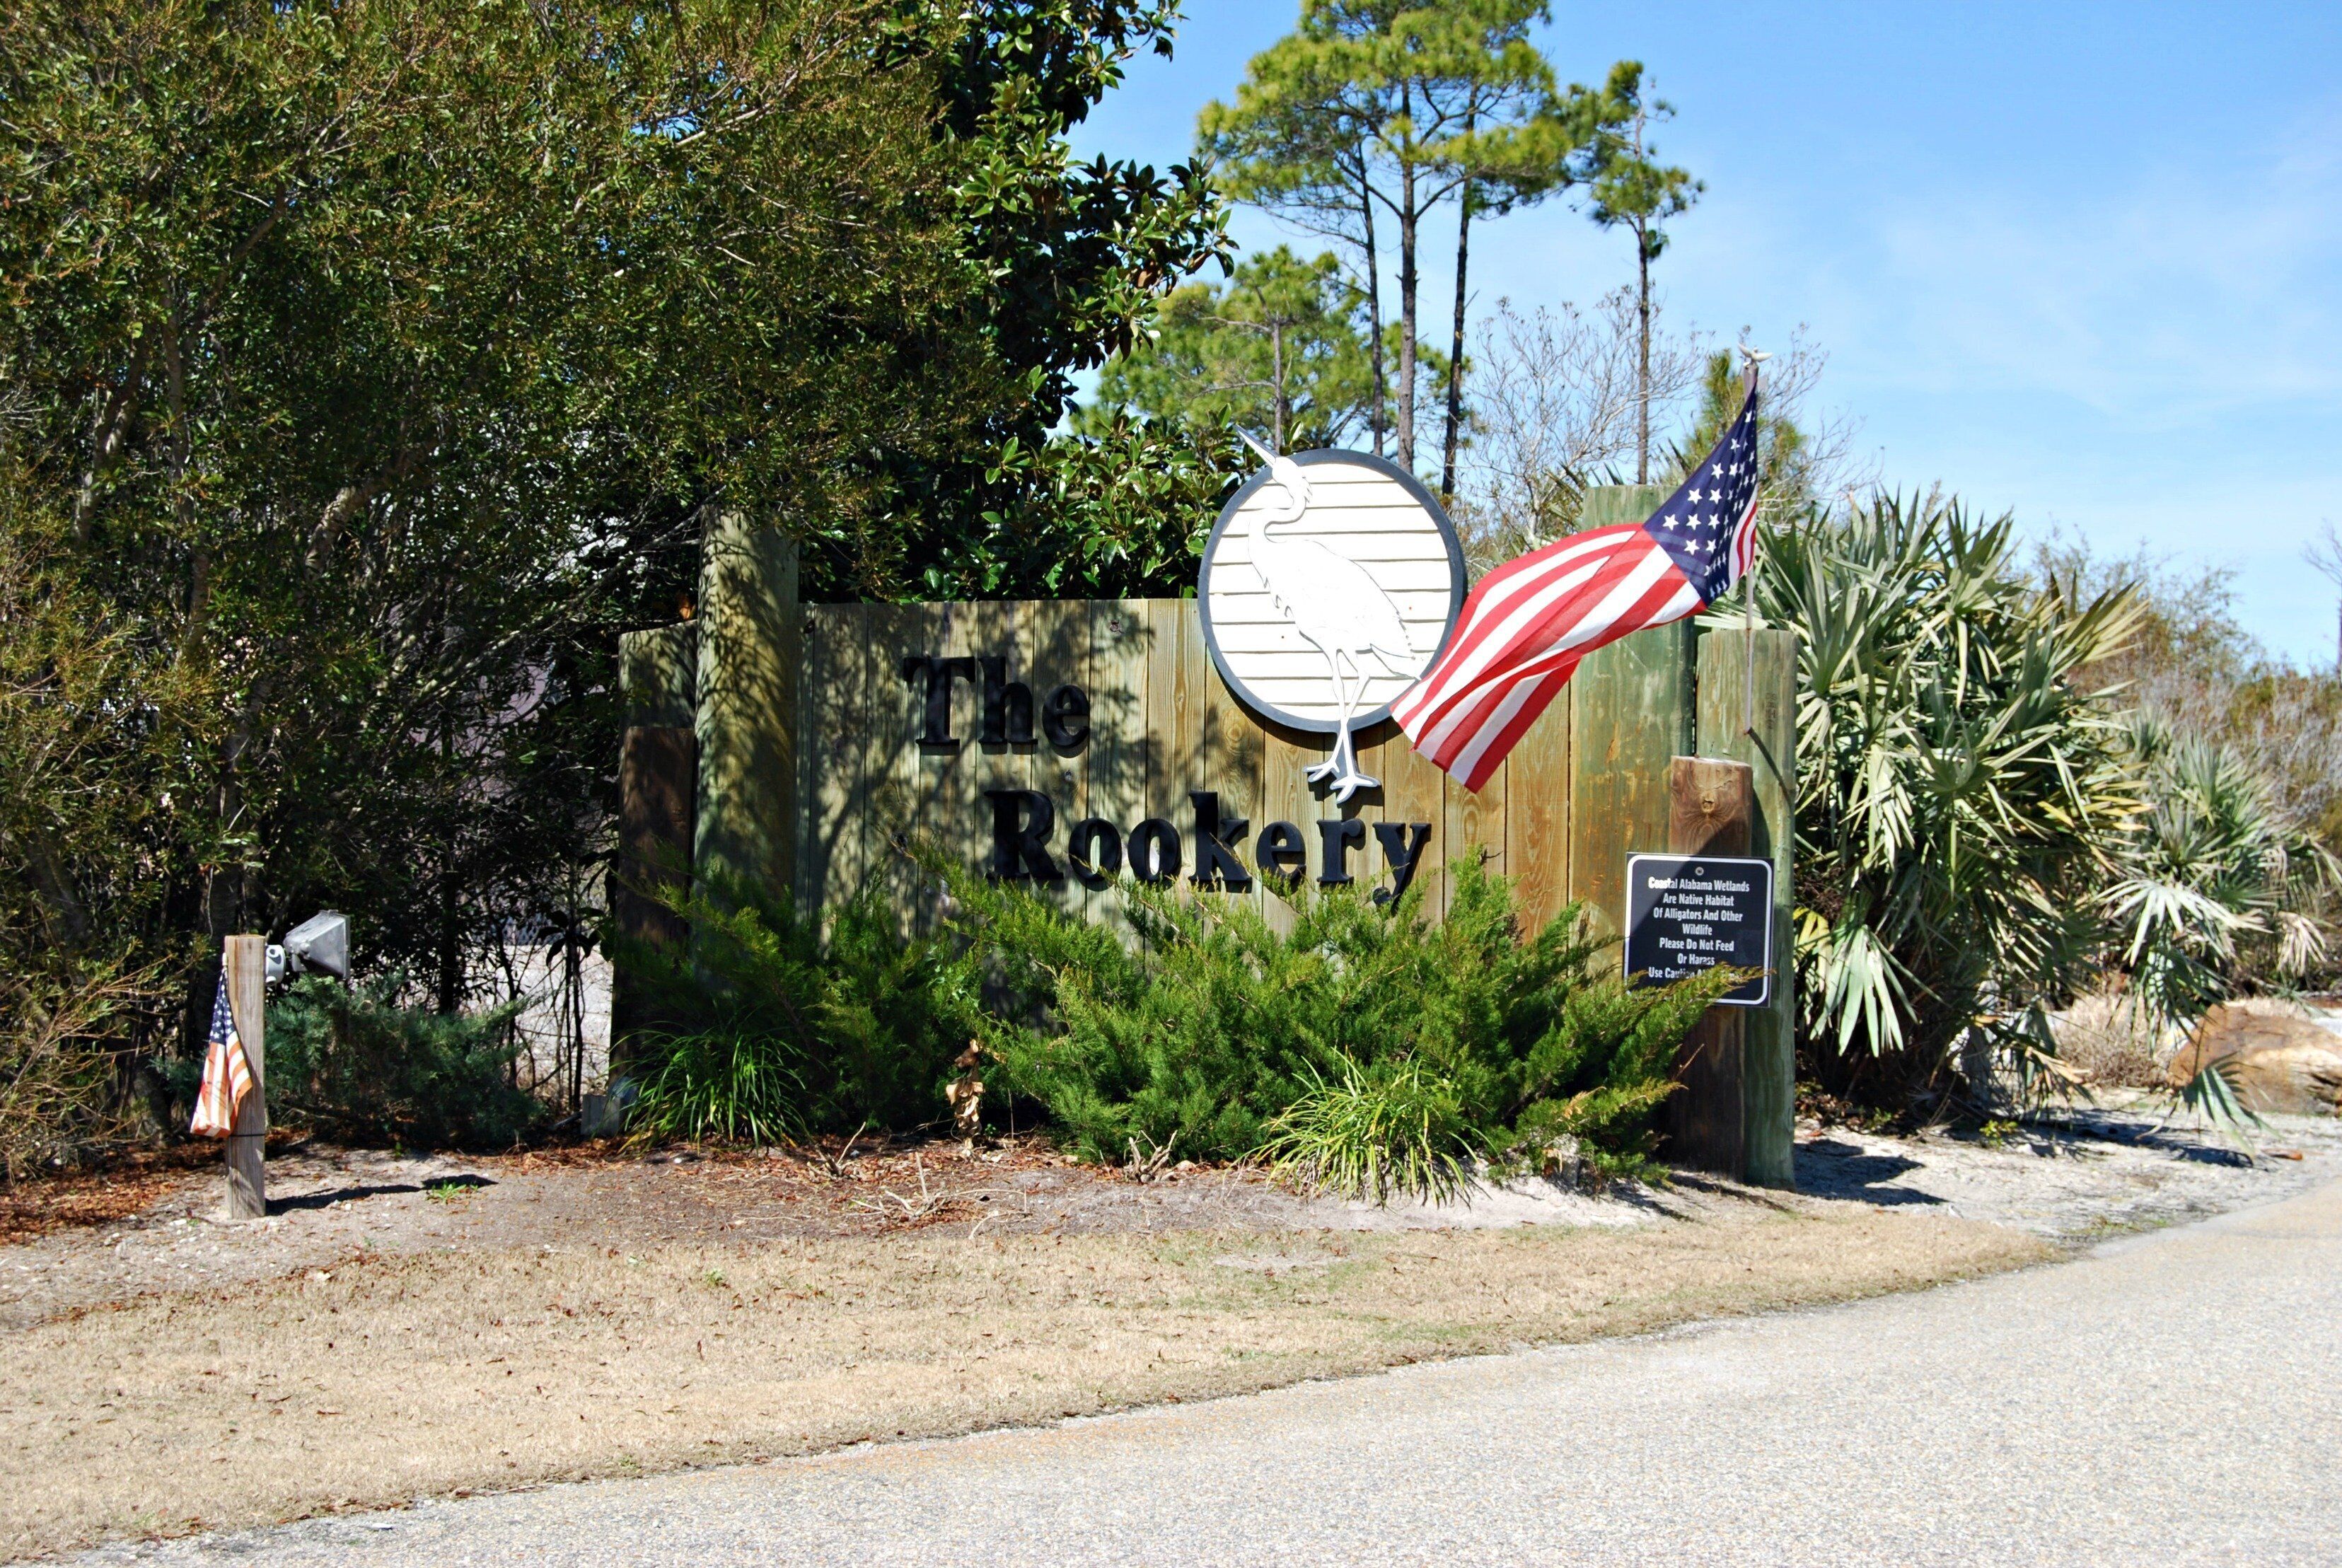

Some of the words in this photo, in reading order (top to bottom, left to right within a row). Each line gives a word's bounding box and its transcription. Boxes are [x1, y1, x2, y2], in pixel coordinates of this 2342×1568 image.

[903, 656, 1090, 749] The
[984, 789, 1432, 907] Rookery
[1648, 876, 1678, 889] Coastal
[1679, 878, 1712, 890] Alabama
[1713, 880, 1750, 892] Wetlands
[1662, 893, 1677, 904] Are
[1679, 894, 1703, 905] Native
[1705, 895, 1734, 906] Habitat
[1653, 907, 1664, 918] Of
[1664, 907, 1702, 921] Alligators
[1703, 910, 1719, 920] And
[1720, 910, 1744, 922] Other
[1682, 923, 1712, 936] Wildlife
[1659, 937, 1684, 949] Please
[1686, 939, 1698, 949] Do
[1699, 939, 1714, 951] Not
[1715, 940, 1734, 951] Feed
[1677, 953, 1687, 964] Or
[1688, 954, 1715, 965] Harass
[1648, 967, 1663, 978] Use
